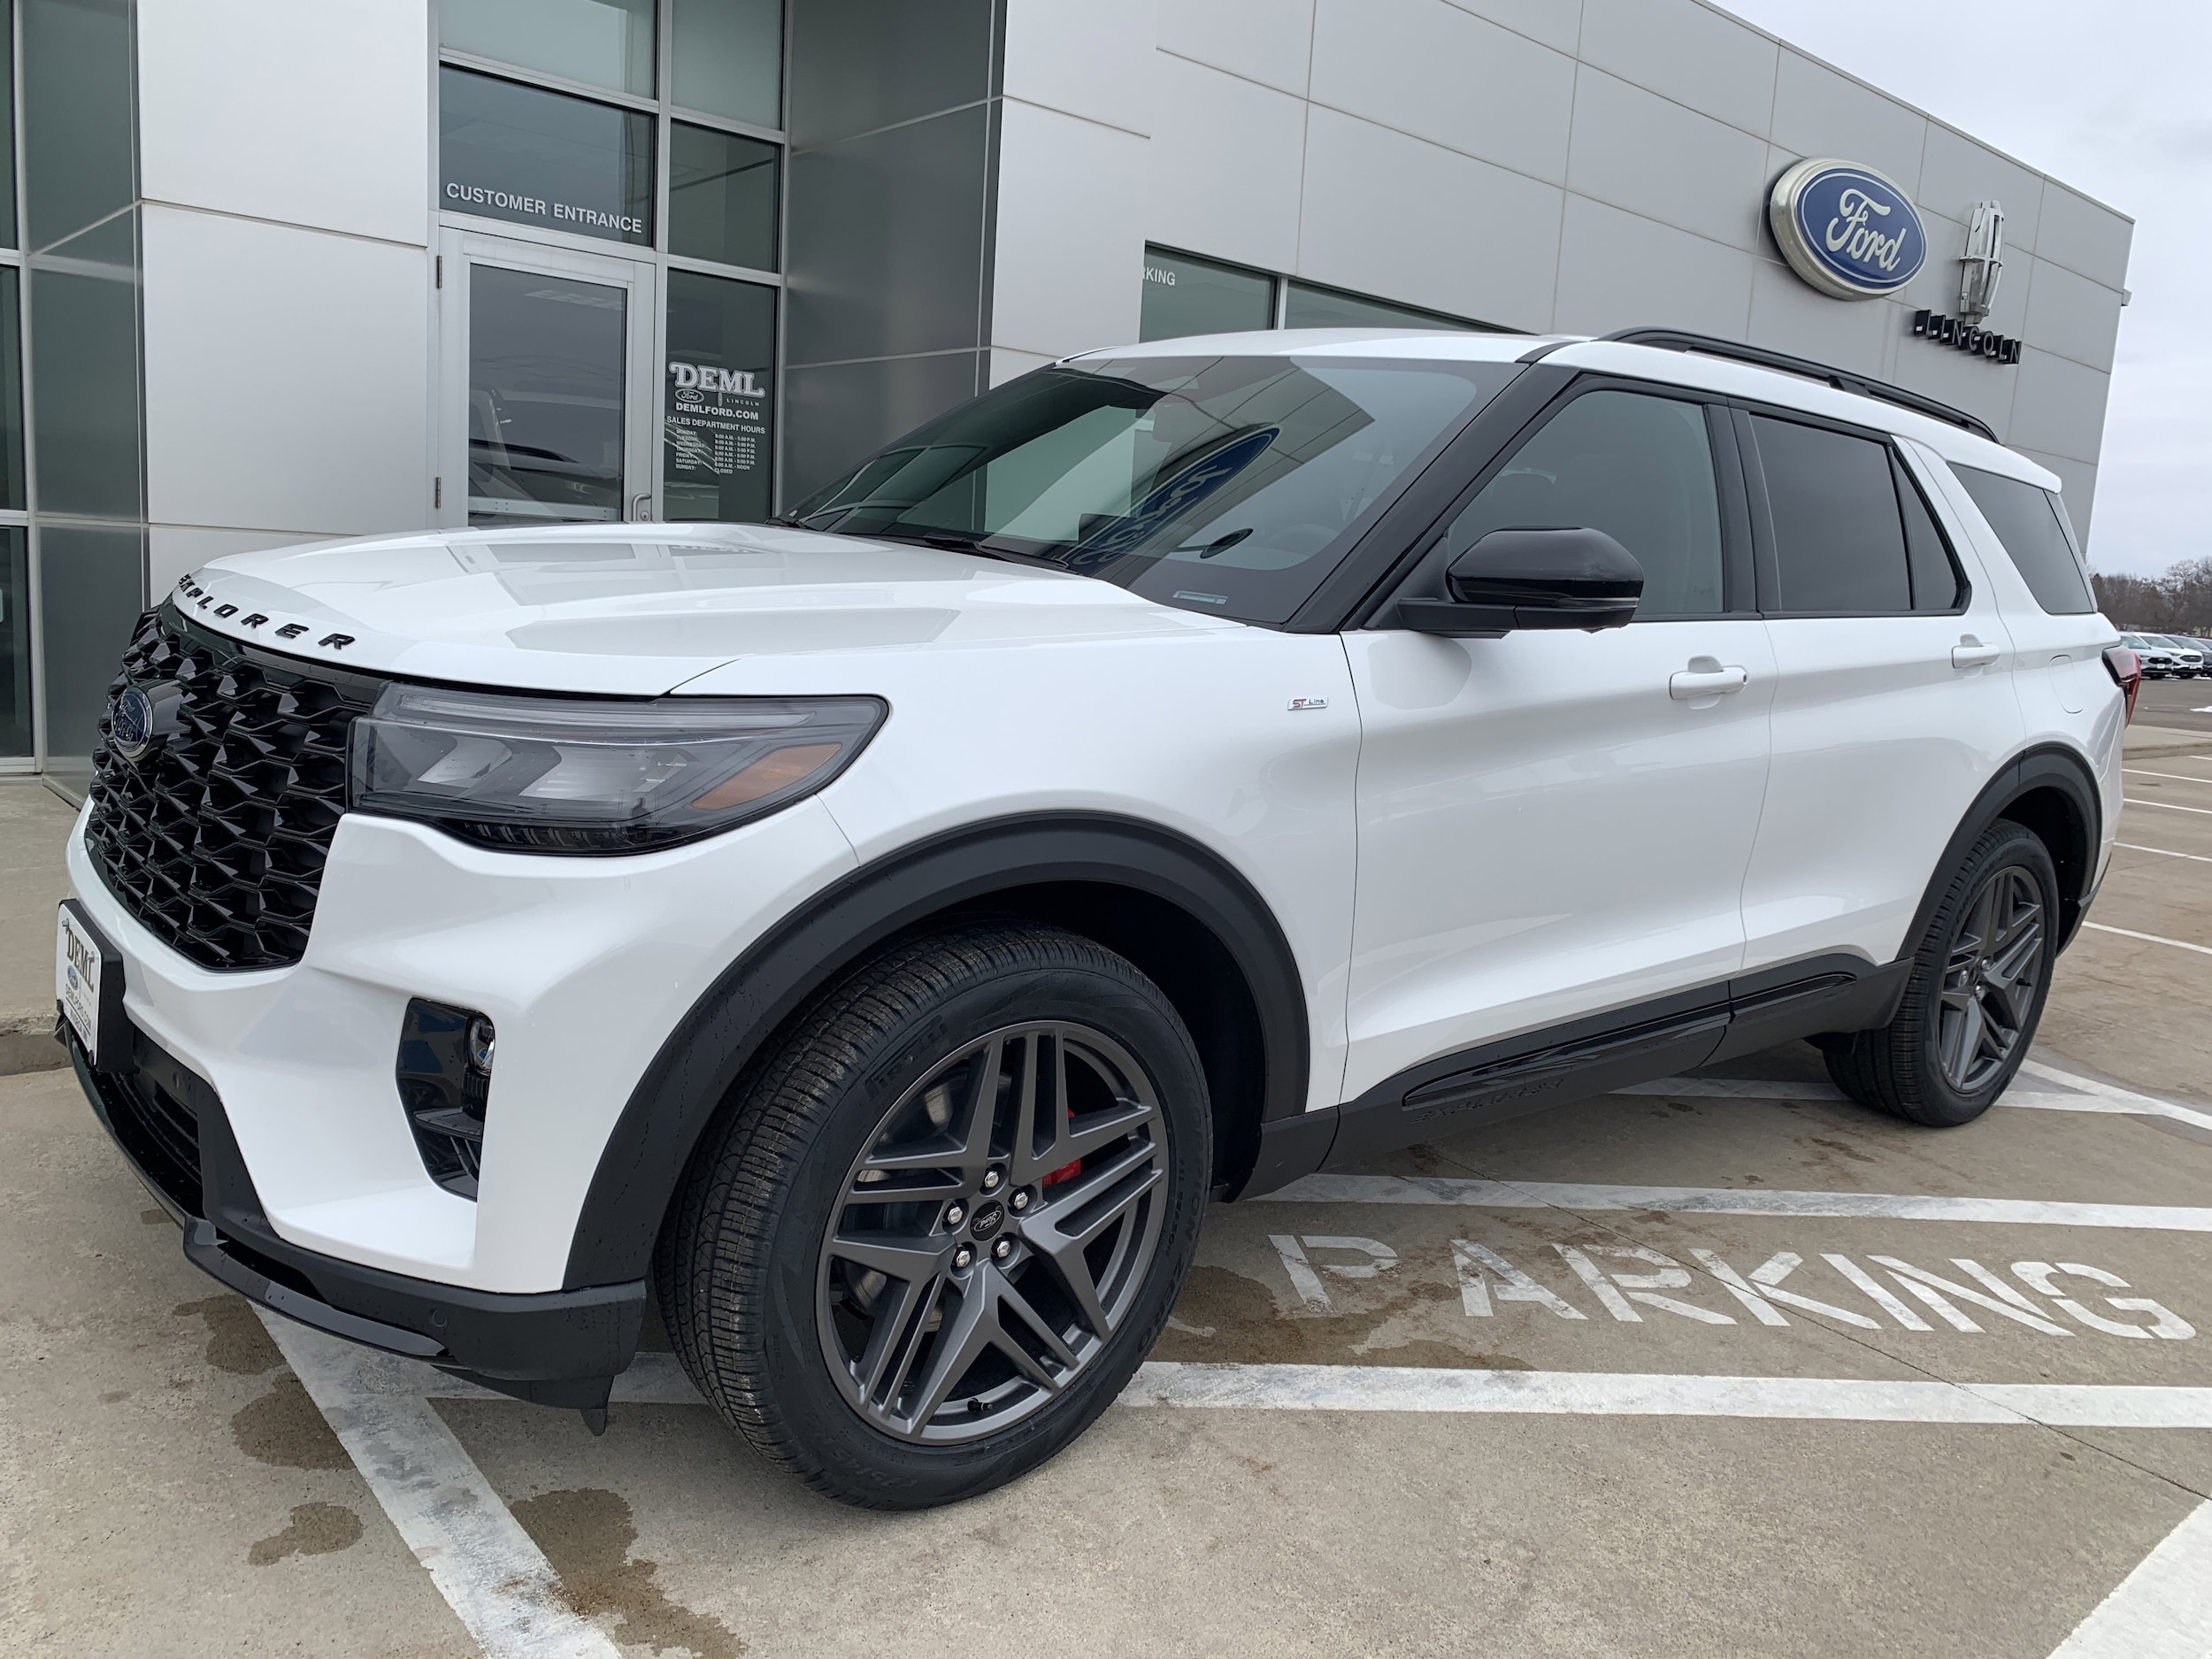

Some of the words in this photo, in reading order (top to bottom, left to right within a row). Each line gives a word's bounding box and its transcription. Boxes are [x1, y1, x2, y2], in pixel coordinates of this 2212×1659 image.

[446, 182, 546, 215] CUSTOMER
[553, 203, 642, 234] ENTRANCE
[1826, 188, 1907, 272] Ford
[1914, 310, 2022, 365] LINCOLN
[668, 362, 766, 398] DEML
[726, 397, 760, 407] LINCOLN
[666, 415, 691, 426] SALES
[692, 419, 740, 431] DEPARTMENT
[741, 425, 766, 434] HOURS
[675, 402, 759, 420] DEMLFORD.COM
[64, 926, 95, 993] DEML
[1269, 1235, 2197, 1340] PARKING
